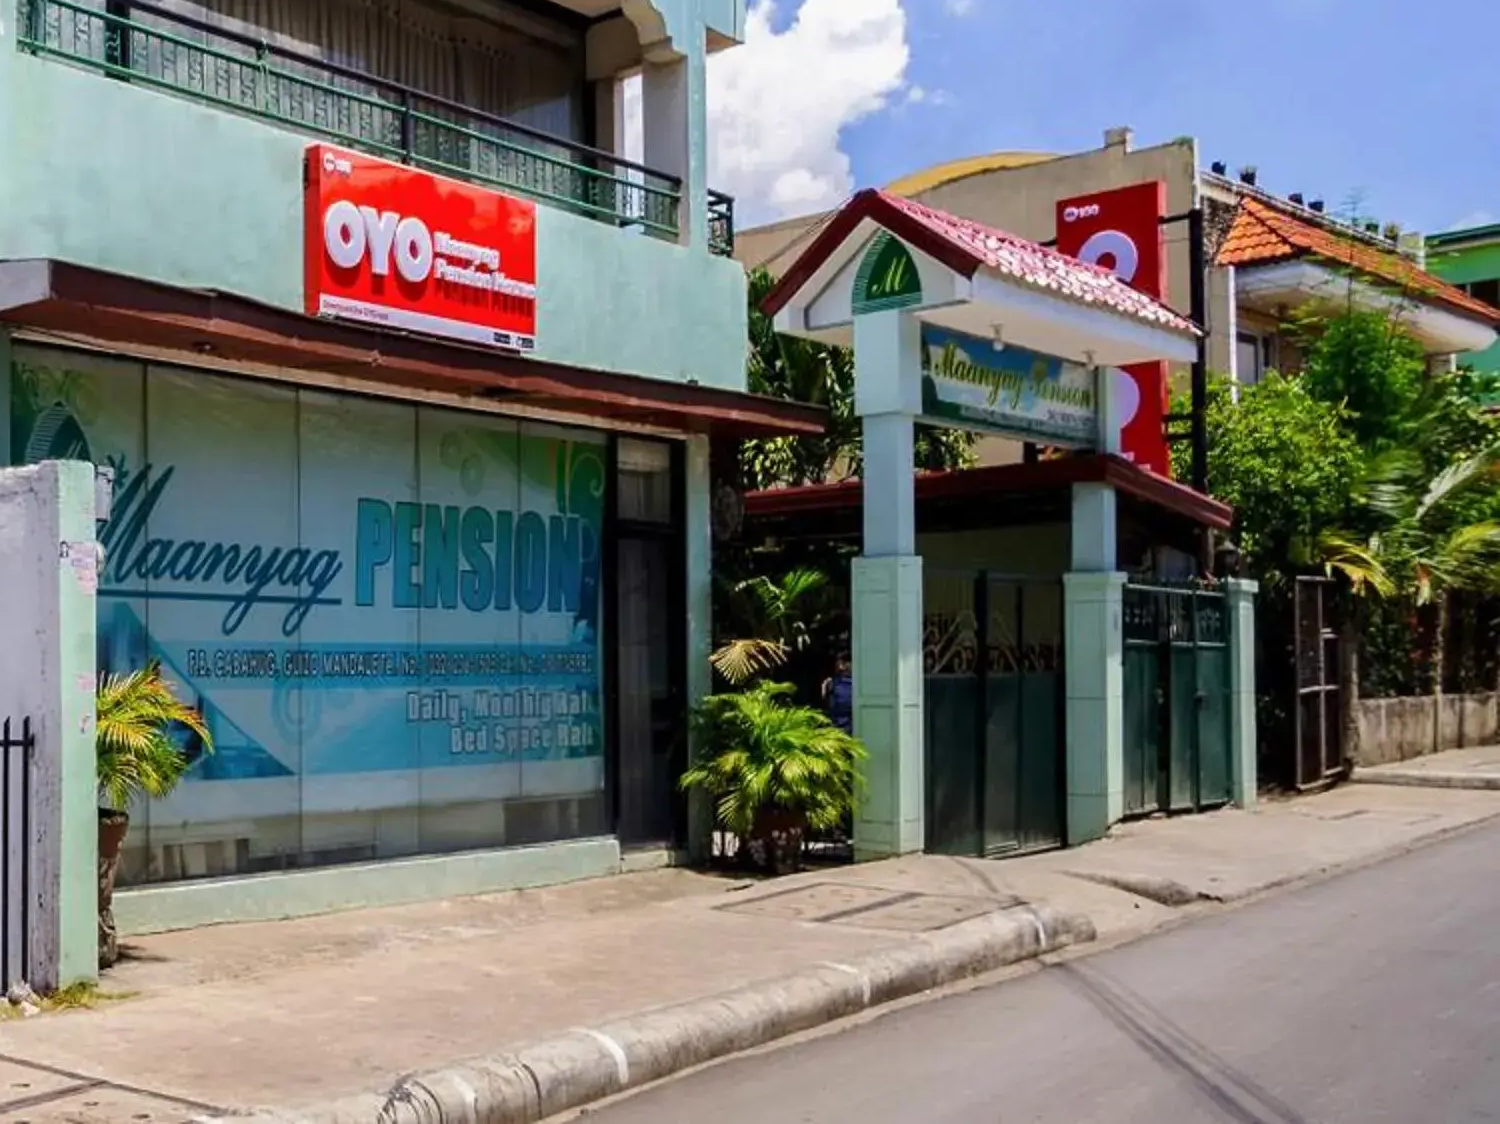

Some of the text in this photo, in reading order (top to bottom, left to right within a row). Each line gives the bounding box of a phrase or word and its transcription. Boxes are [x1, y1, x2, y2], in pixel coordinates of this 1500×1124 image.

[324, 200, 433, 283] OYO
[98, 461, 582, 637] Maanyag PENSION
[407, 690, 467, 724] Daily,
[451, 726, 488, 753] Bed
[494, 724, 550, 756] Space
